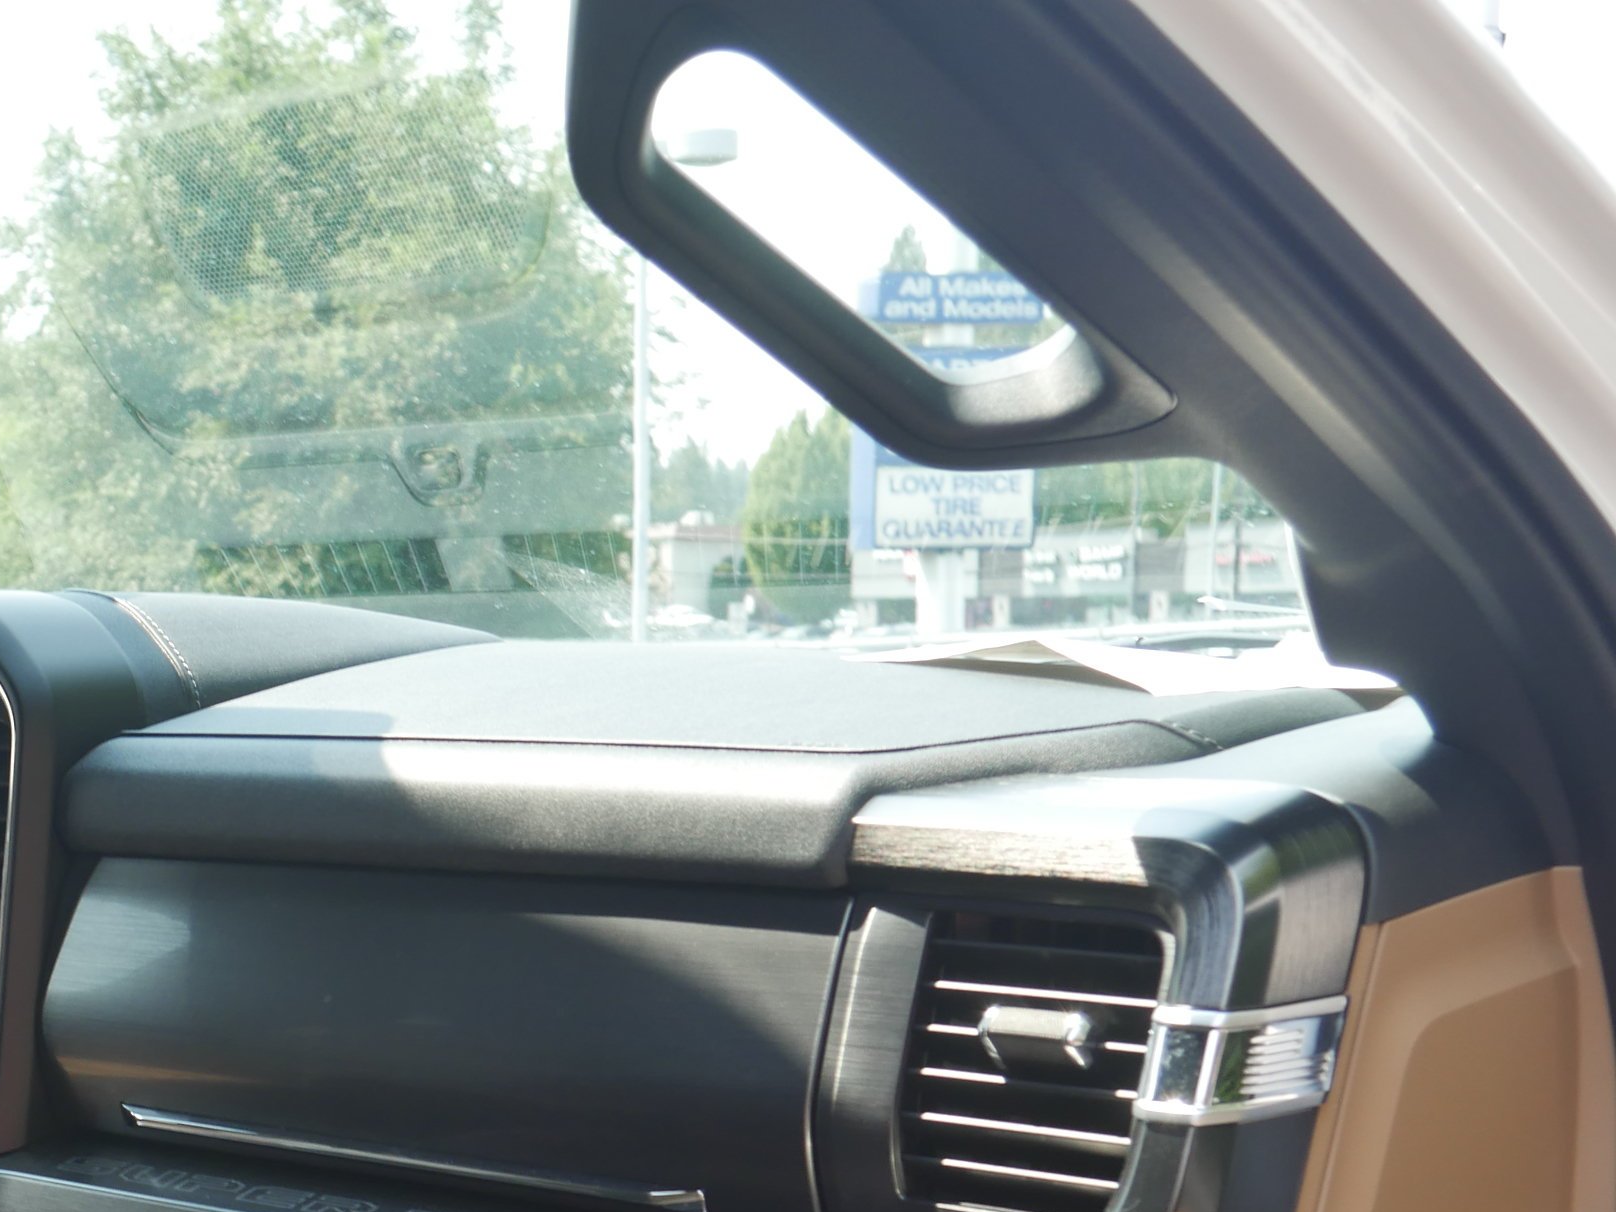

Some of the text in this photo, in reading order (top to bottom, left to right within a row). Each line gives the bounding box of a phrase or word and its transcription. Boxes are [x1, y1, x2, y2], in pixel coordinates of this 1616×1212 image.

[898, 276, 1028, 298] All Makes
[884, 298, 1038, 319] and Models
[889, 474, 1022, 494] LOW PRICE
[931, 498, 981, 515] TIRE
[884, 519, 1027, 540] GUARANTEE
